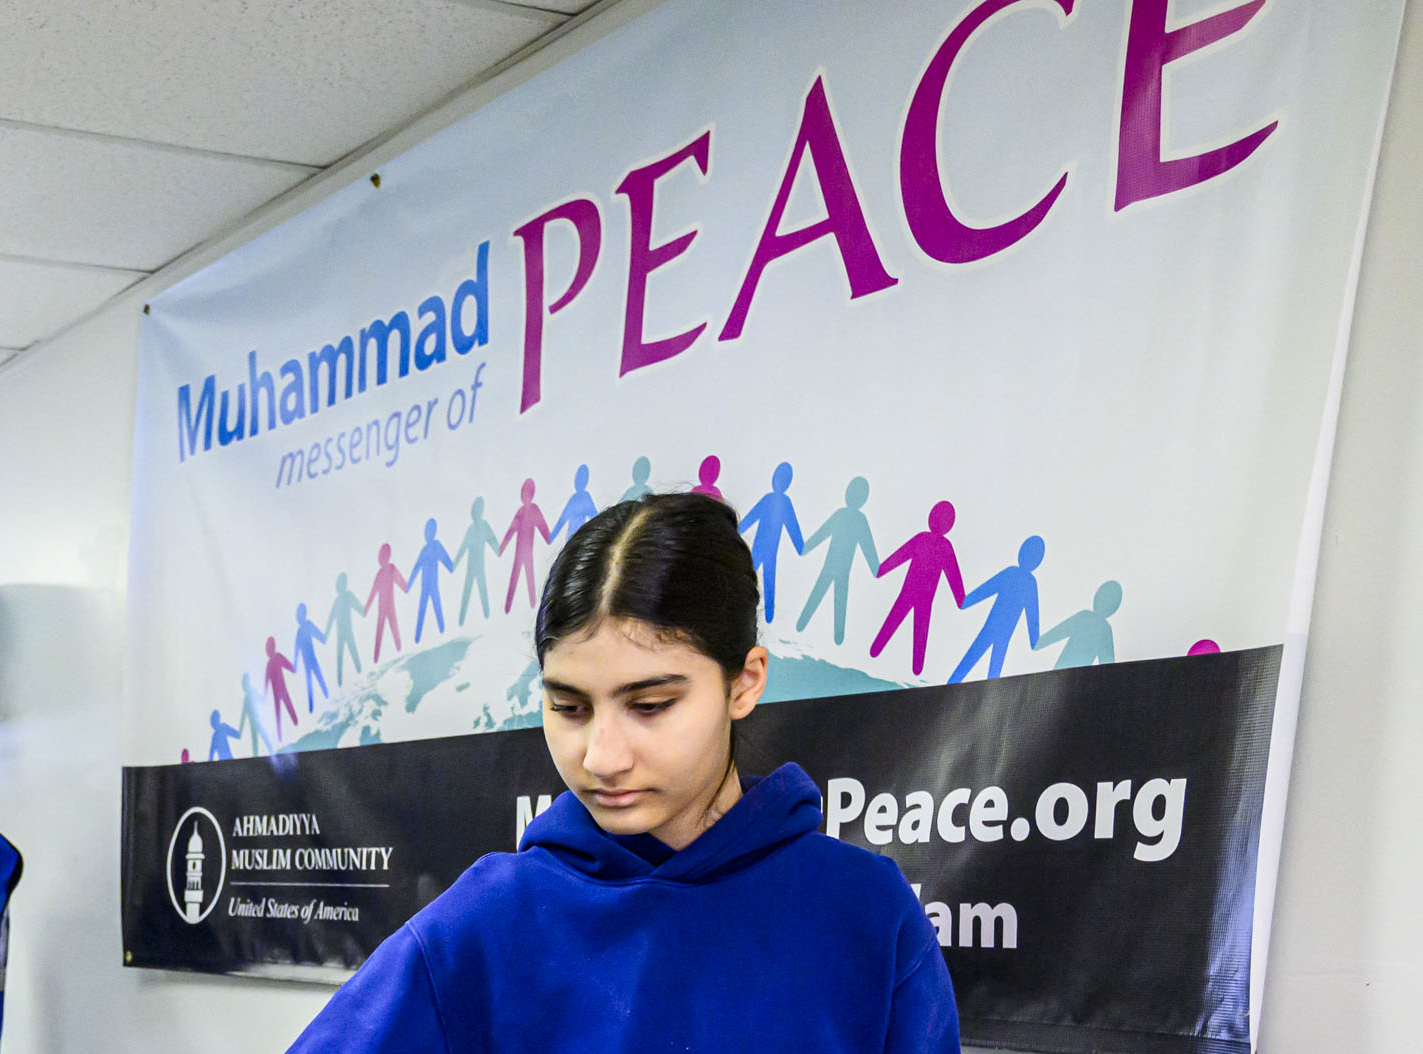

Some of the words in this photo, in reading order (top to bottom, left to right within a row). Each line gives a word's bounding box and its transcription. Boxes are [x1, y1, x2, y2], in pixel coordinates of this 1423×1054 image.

[512, 0, 1279, 414] PEACE
[177, 240, 491, 463] Muhammad
[275, 397, 440, 489] messenger
[446, 361, 487, 432] of
[231, 848, 291, 871] MUSLIM
[295, 847, 394, 871] COMMUNITY
[232, 813, 321, 837] AHMADIYYA
[821, 776, 1188, 862] Peace.org
[228, 897, 264, 918] United
[266, 898, 299, 919] States
[300, 898, 316, 925] of
[313, 901, 360, 922] America
